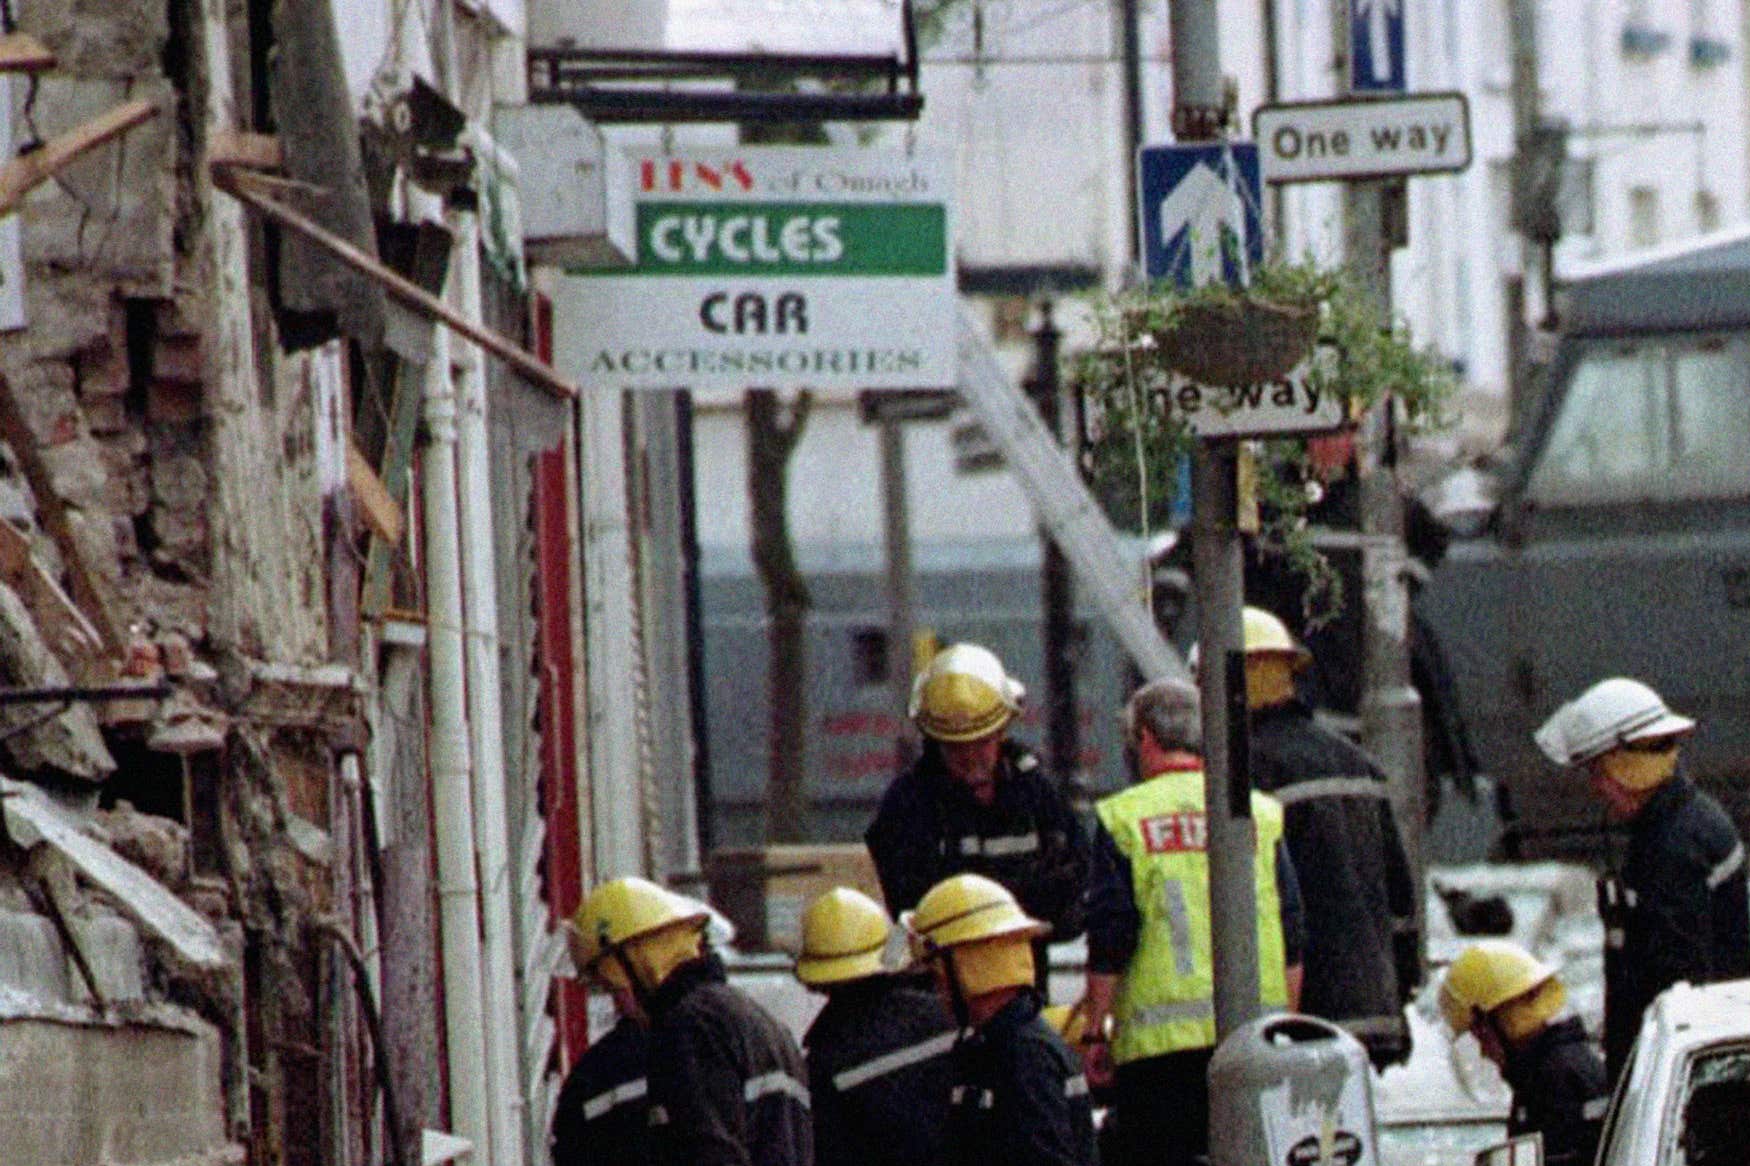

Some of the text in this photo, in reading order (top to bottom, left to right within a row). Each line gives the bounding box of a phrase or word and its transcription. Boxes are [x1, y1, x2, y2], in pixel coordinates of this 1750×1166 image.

[1273, 124, 1451, 159] One way
[652, 215, 844, 263] CYCLES
[699, 290, 808, 334] CAR
[592, 349, 922, 375] ACCESSORIES
